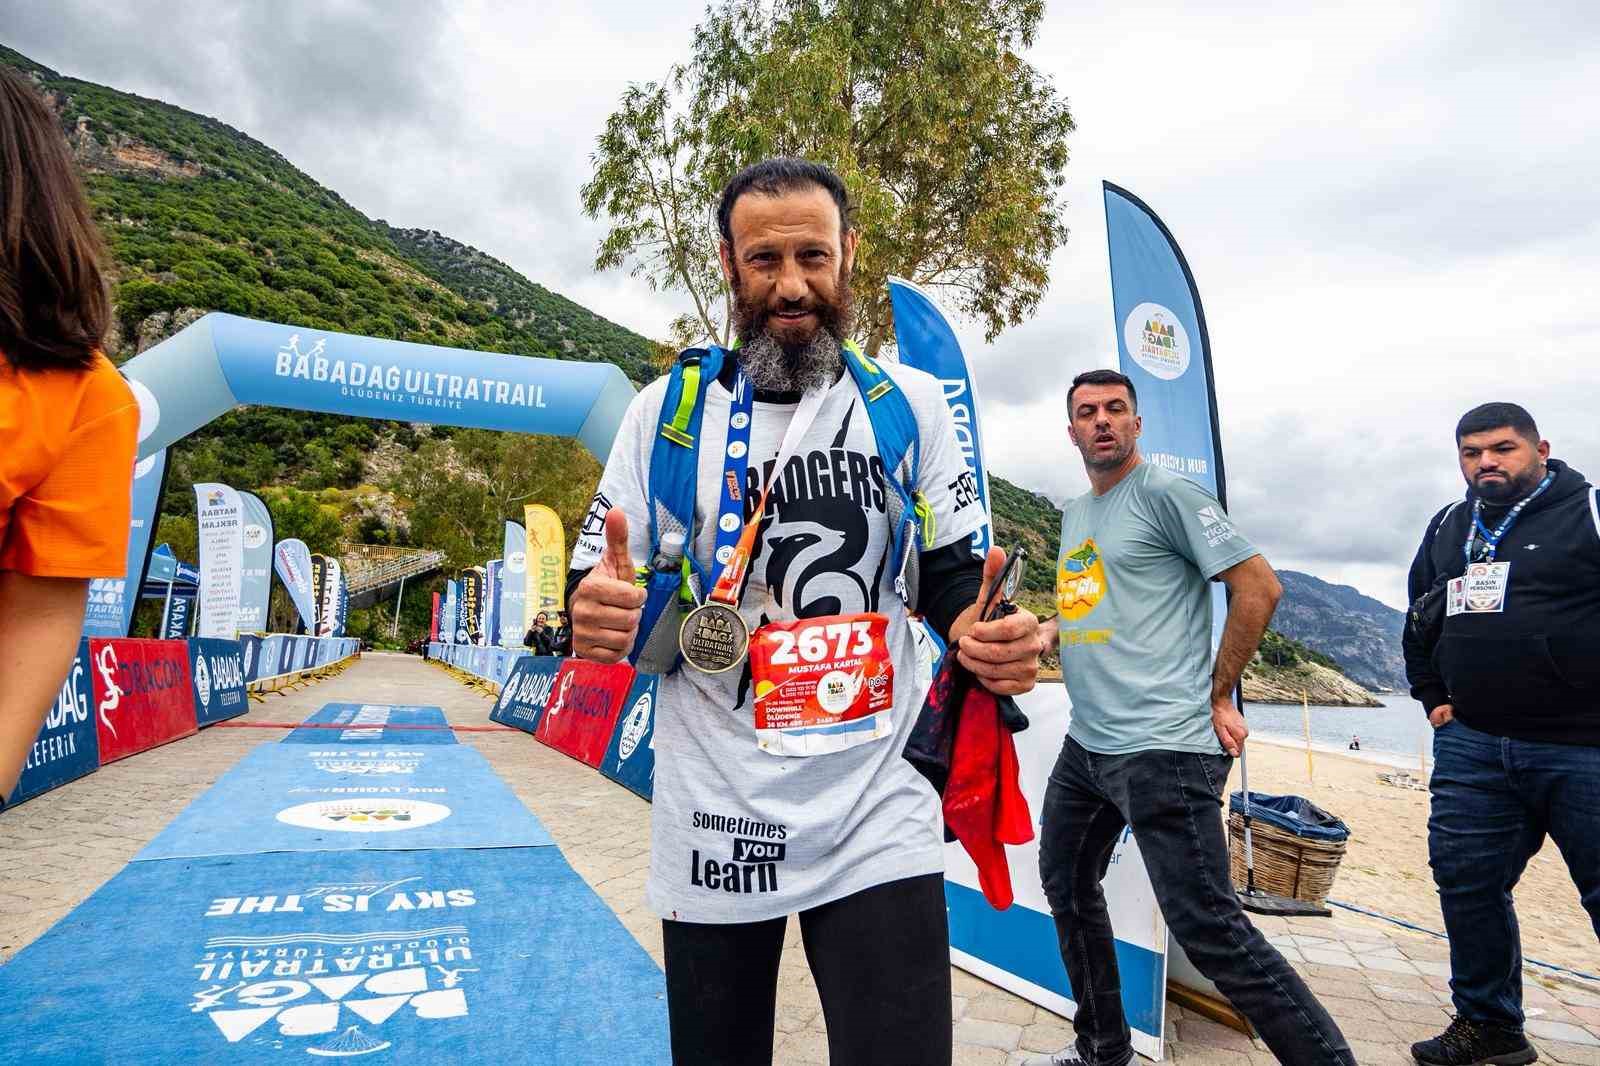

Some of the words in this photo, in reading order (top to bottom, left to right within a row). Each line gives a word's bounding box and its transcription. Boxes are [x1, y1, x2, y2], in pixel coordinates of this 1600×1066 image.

[404, 369, 546, 409] ULTRATRAIL
[746, 449, 887, 521] BADGERS
[767, 621, 873, 665] 2673
[788, 663, 832, 674] MUSTAFA
[692, 810, 787, 840] sometimes
[739, 841, 779, 860] you
[691, 849, 778, 893] Learn
[204, 894, 304, 917] THE
[323, 893, 369, 913] IS
[387, 888, 477, 911] SKY
[194, 946, 473, 981] ULTRATRAIL
